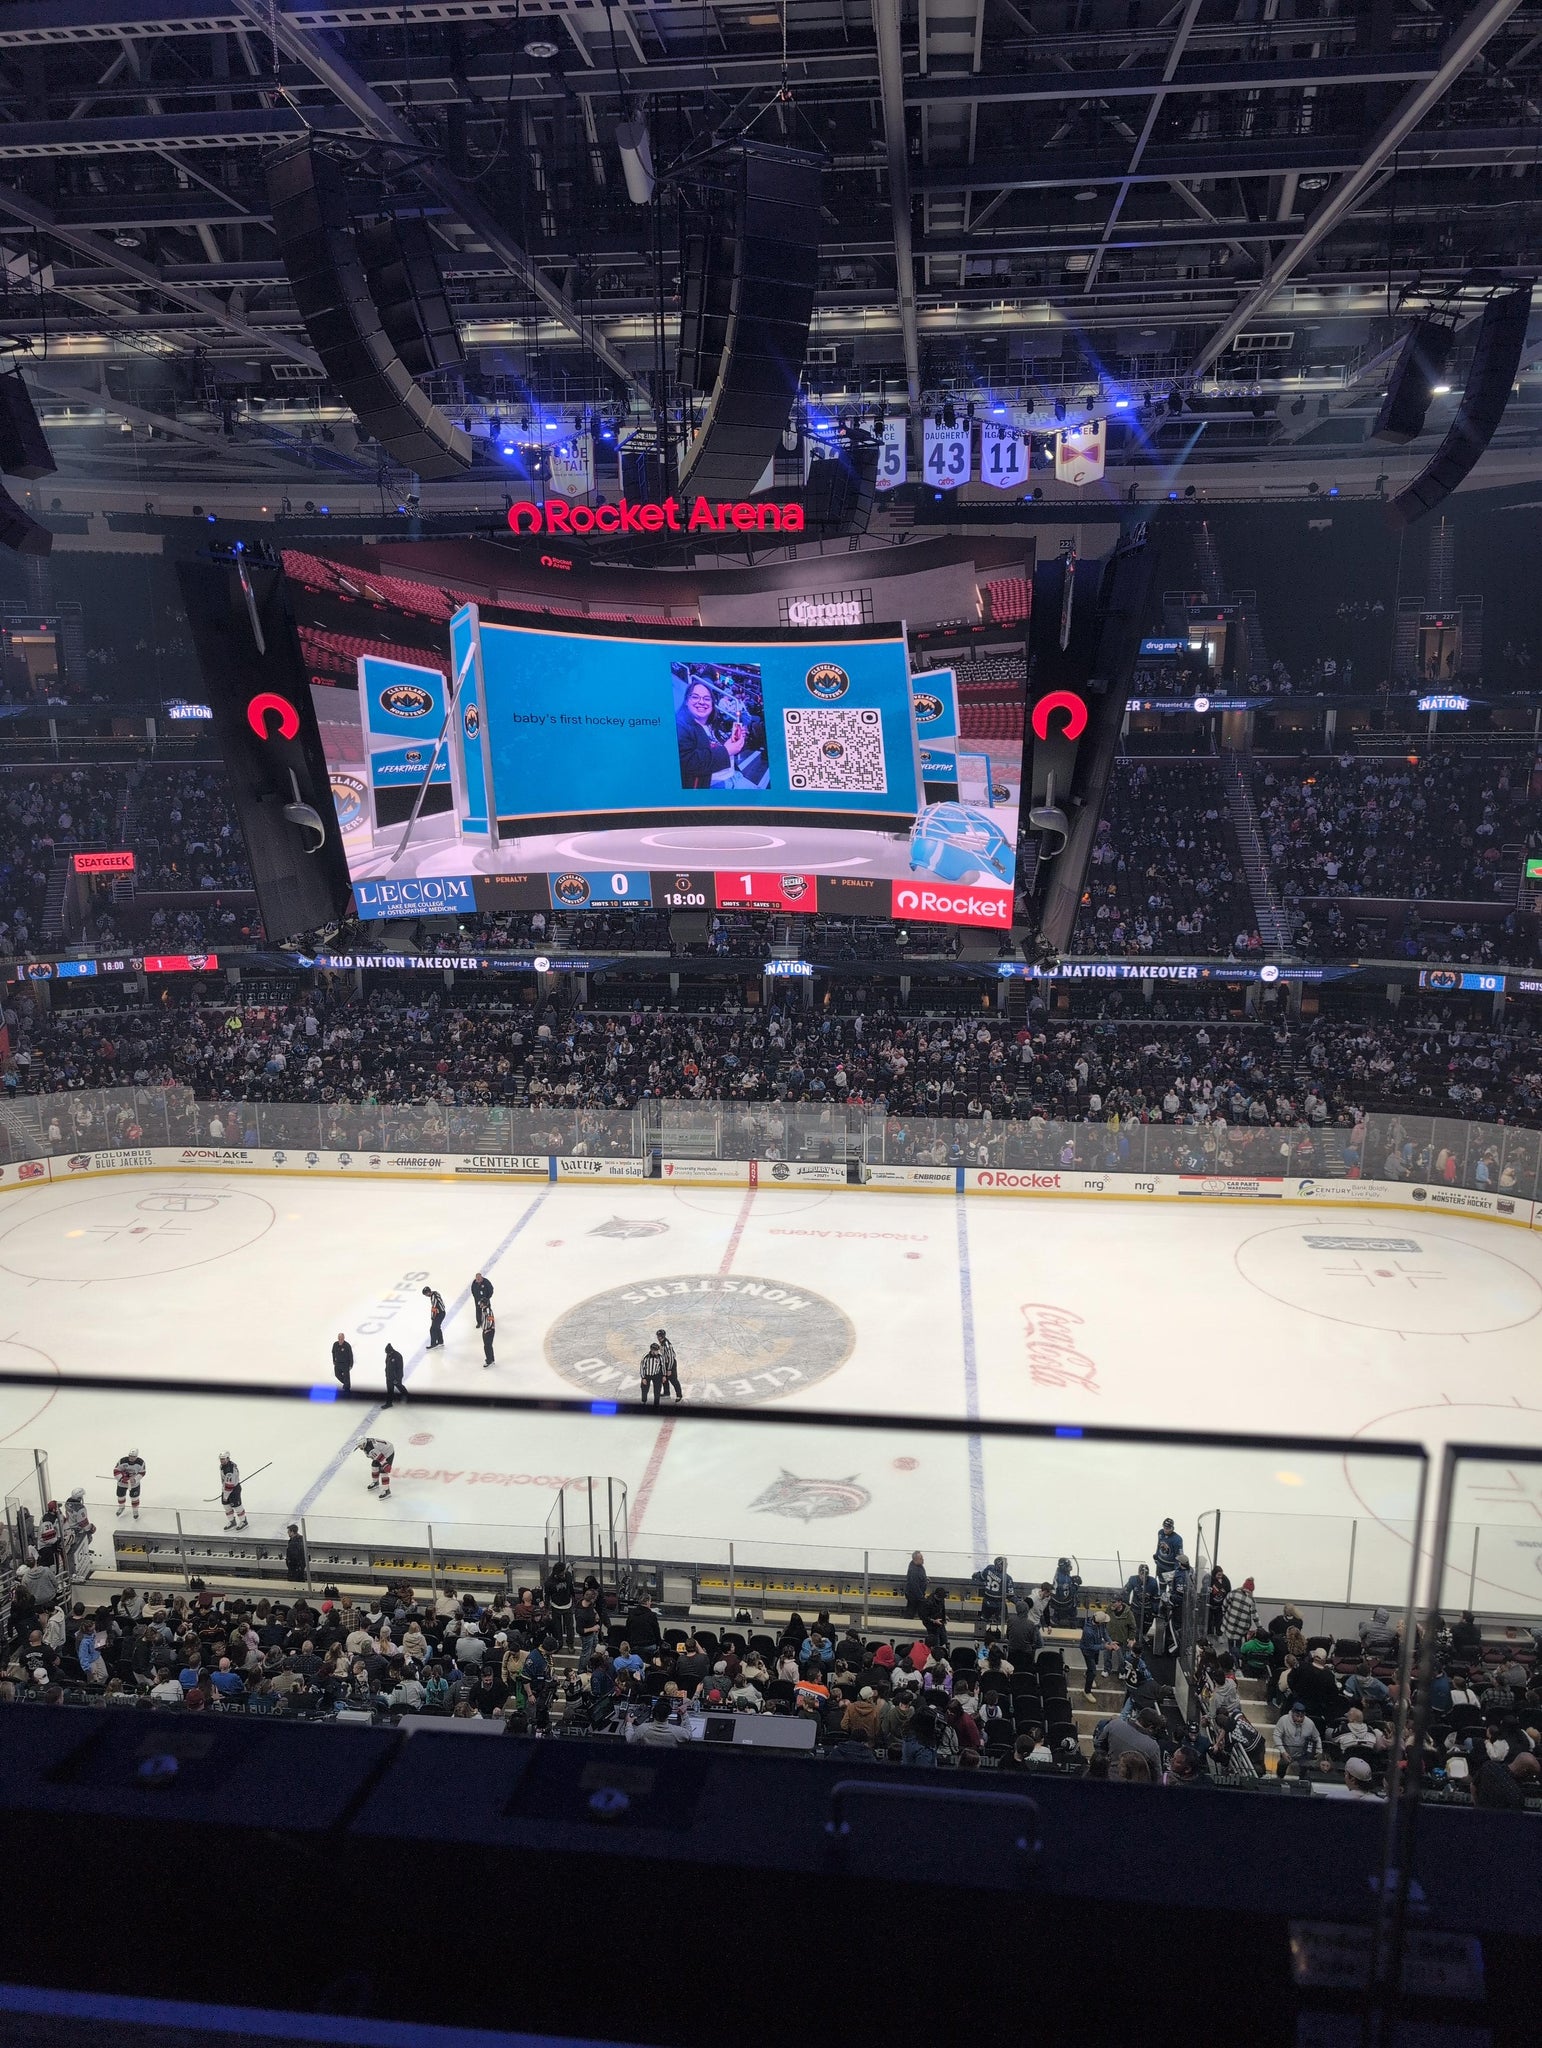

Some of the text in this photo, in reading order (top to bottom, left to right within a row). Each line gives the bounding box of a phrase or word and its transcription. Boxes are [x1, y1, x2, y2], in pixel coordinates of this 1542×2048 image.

[869, 423, 895, 431] MRK
[925, 431, 970, 441] DAUGHERTY
[566, 447, 588, 459] JOE
[928, 443, 965, 475] 43
[990, 442, 1019, 473] 11
[564, 460, 589, 472] TAIT
[545, 496, 805, 533] Rocket Arena
[552, 557, 573, 566] Rocket
[788, 600, 862, 624] Corona
[1146, 642, 1163, 651] drug
[810, 664, 843, 676] CLEVELAND
[387, 685, 427, 698] CLEVELAND
[813, 687, 844, 699] MONSTERS
[1421, 698, 1465, 710] NATION
[171, 708, 211, 718] NATION
[389, 707, 427, 717] MONSTERS
[513, 712, 661, 728] baby's first hockey game!
[377, 763, 446, 773] #FEARTHEDETHS
[78, 856, 130, 868] SEATGEEK
[495, 876, 528, 884] PENALTY
[558, 873, 585, 884] CLEVELAND
[611, 873, 629, 895] 0
[739, 874, 752, 895] 1
[842, 879, 874, 887] PENALTY
[560, 895, 586, 905] MONSTERS
[664, 893, 705, 906] 18:00
[921, 892, 1007, 918] Rocket
[387, 908, 428, 916] OSTEOPATHIC
[428, 905, 457, 913] MEDICINE
[103, 961, 124, 971] 18:00
[157, 960, 163, 968] 1
[330, 956, 353, 967] KID
[356, 956, 405, 968] NATION
[408, 957, 478, 969] TAKEOVER
[768, 963, 810, 975] NATION
[1063, 965, 1116, 977] NATION
[1121, 966, 1198, 978] TAKEOVER
[1480, 977, 1496, 988] 10
[95, 1150, 152, 1159] COLUMBUS
[96, 1157, 153, 1168] BLUE JACKETS
[472, 1156, 541, 1168] CENTER ICE
[1187, 1157, 1198, 1168] 37
[914, 1173, 952, 1181] ENBRIDGE
[995, 1171, 1061, 1188] Rocket
[1084, 1180, 1104, 1191] nrg
[1135, 1181, 1154, 1193] nrg
[1315, 1187, 1350, 1195] CENTURY
[1431, 1194, 1466, 1206] MONSTERS
[1467, 1198, 1493, 1209] HOCKEY
[768, 1228, 909, 1241] Rocket Arena
[620, 1279, 814, 1312] MONSTERS
[356, 1271, 431, 1335] CLIFFS
[1020, 1303, 1101, 1396] Coca-Cola
[391, 1467, 573, 1490] Rocket Aren
